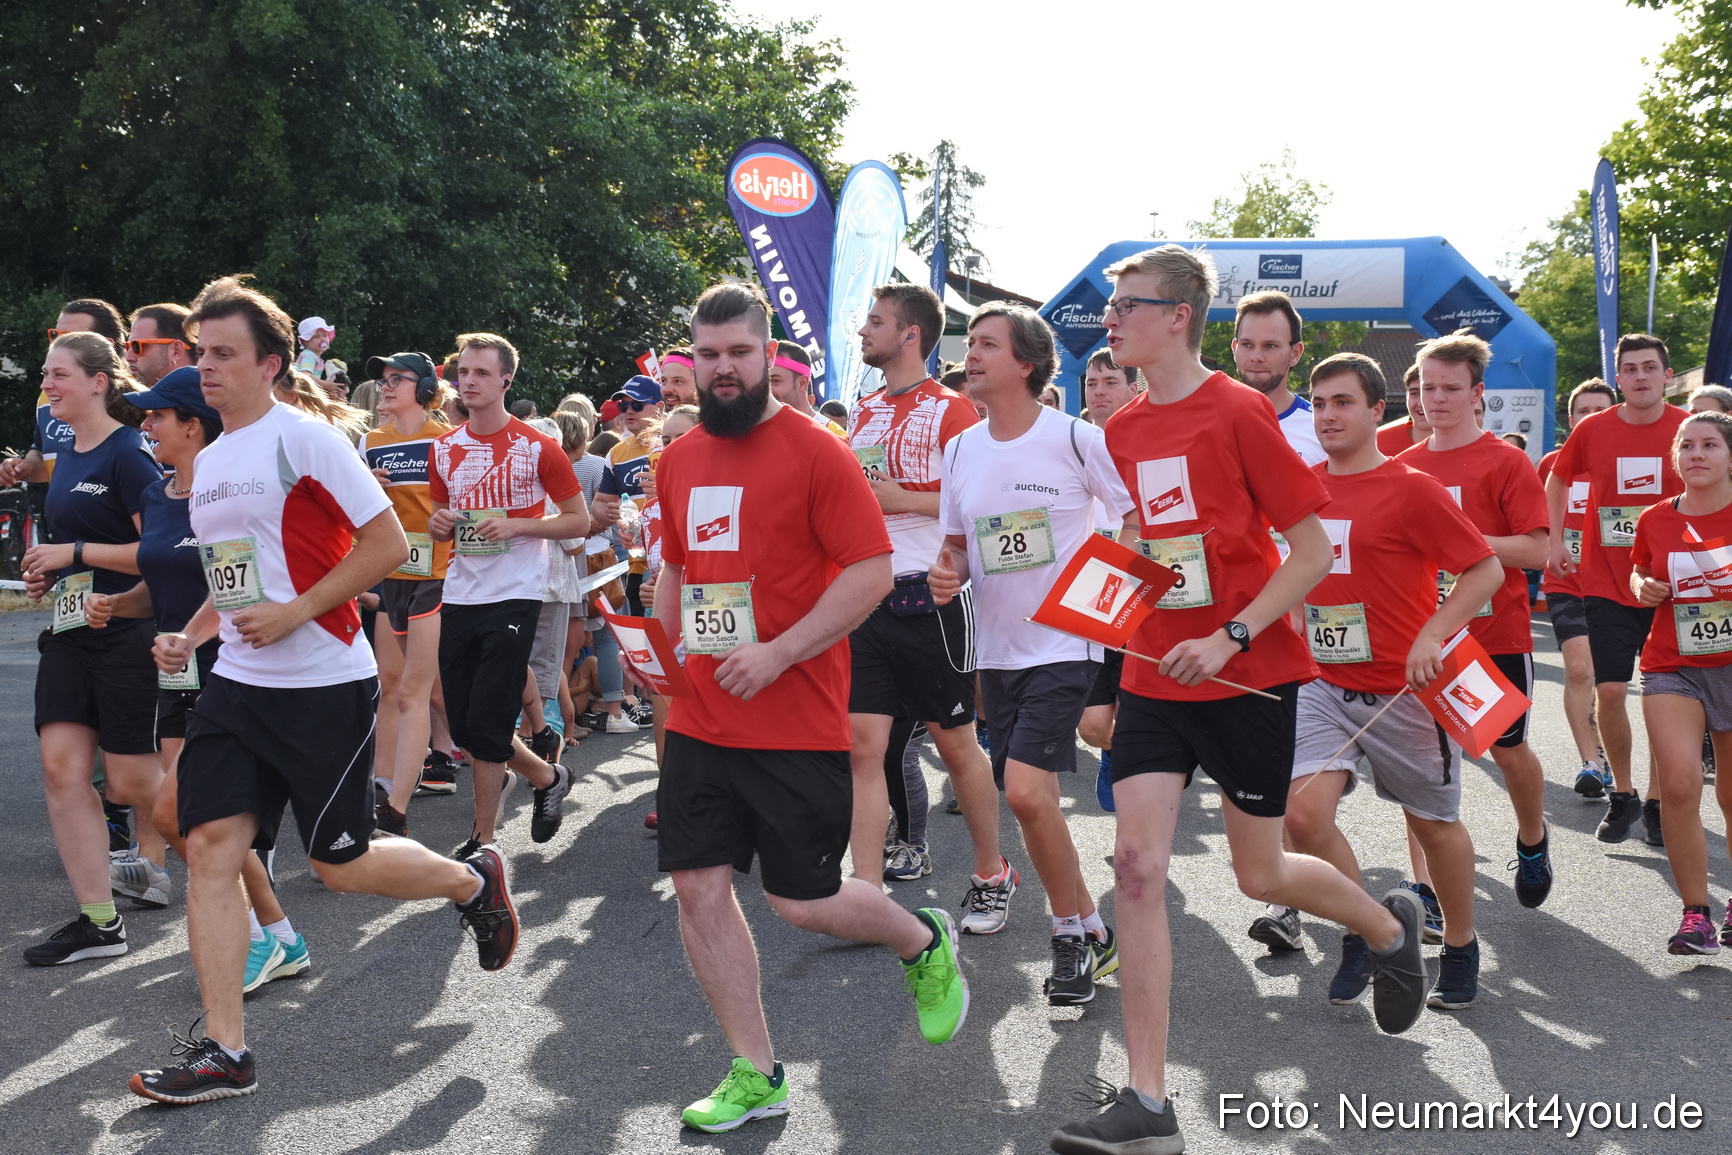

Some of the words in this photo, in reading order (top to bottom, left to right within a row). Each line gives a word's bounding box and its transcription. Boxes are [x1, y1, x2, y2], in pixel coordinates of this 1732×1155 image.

[1061, 312, 1104, 322] Fische
[1456, 310, 1471, 318] das
[196, 477, 264, 508] intellitools
[1014, 483, 1060, 496] auctores
[1158, 494, 1174, 510] DEHN
[460, 526, 487, 542] 22
[1613, 522, 1638, 535] 46
[998, 532, 1026, 556] 28
[1181, 554, 1198, 562] 2019
[208, 562, 247, 592] 1097
[1104, 584, 1115, 604] DEHN
[57, 592, 84, 618] 1381
[1114, 608, 1133, 629] DEHN
[1130, 584, 1154, 610] protects.
[695, 608, 736, 635] 550
[1690, 618, 1732, 640] 494
[1314, 626, 1348, 648] 467
[1712, 637, 1732, 645] Barbar
[1434, 694, 1449, 711] DEHN
[1444, 710, 1468, 734] protects.
